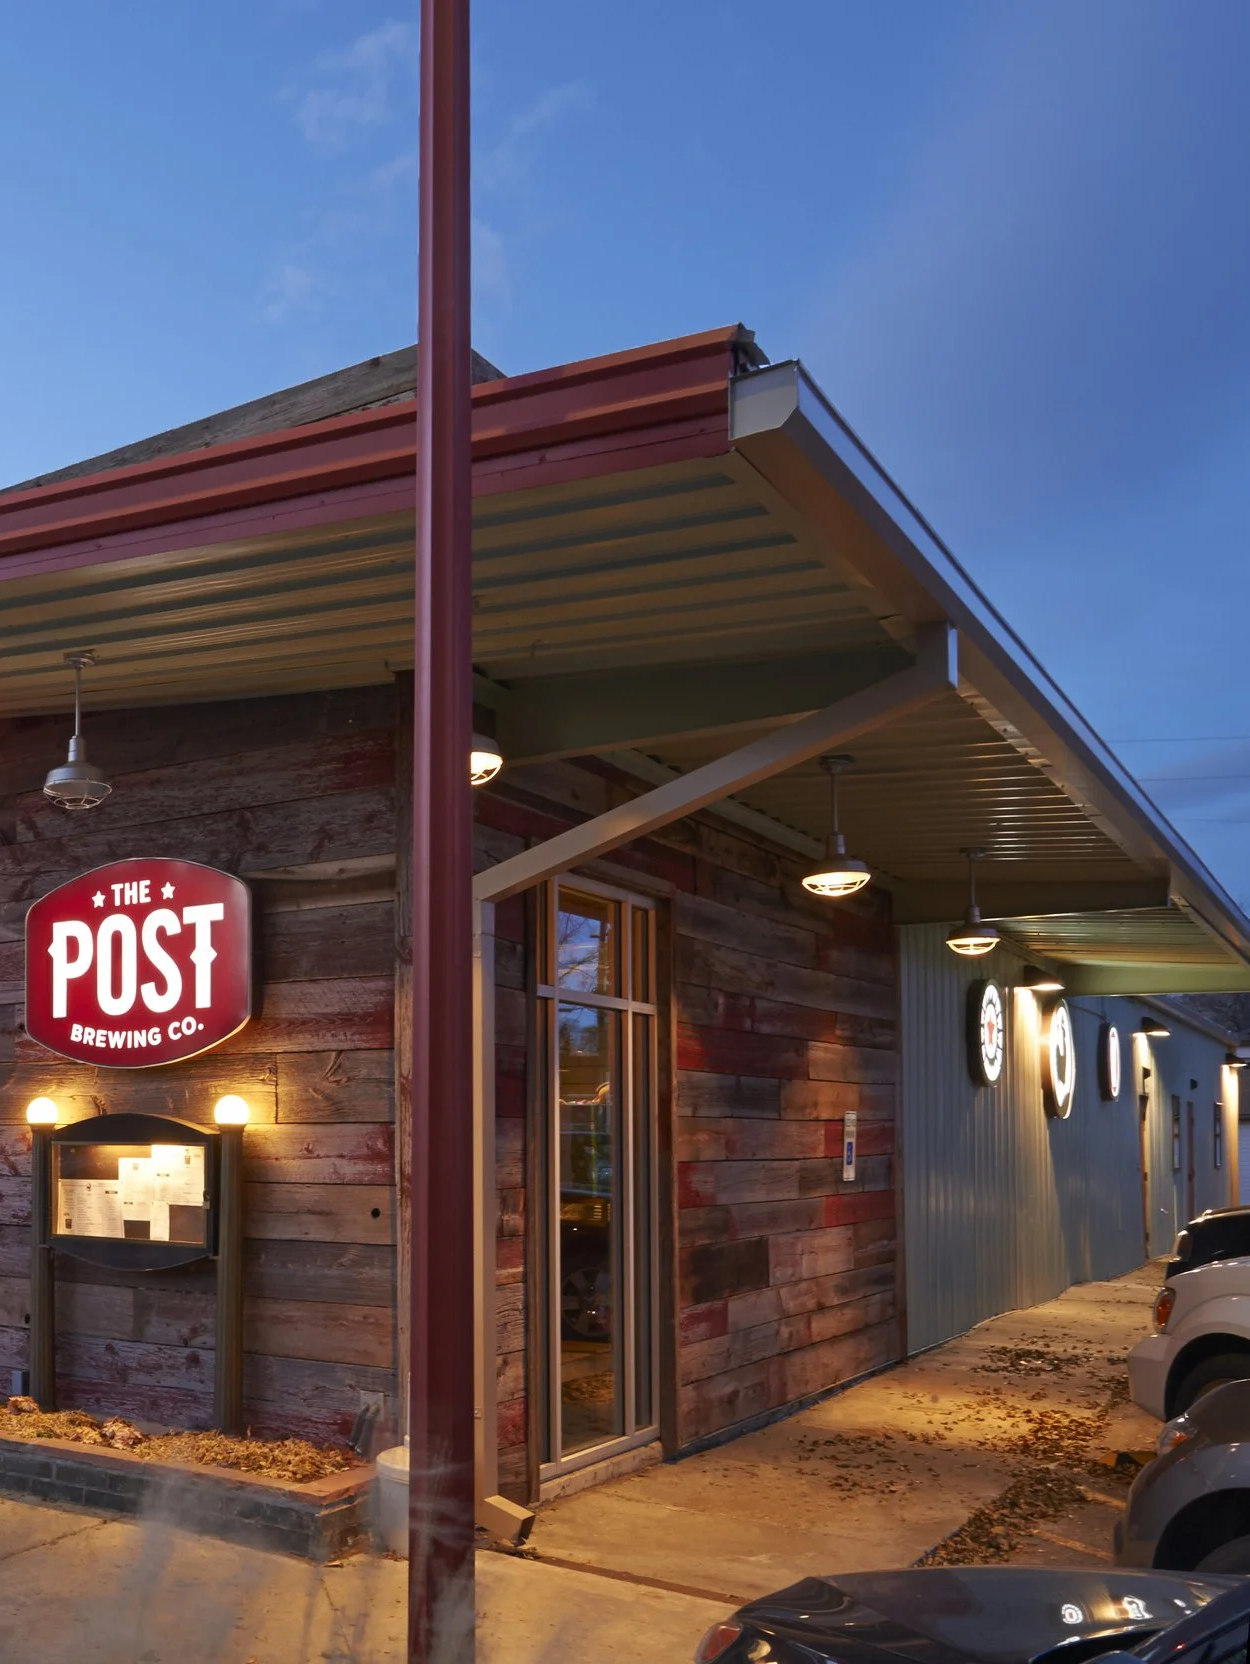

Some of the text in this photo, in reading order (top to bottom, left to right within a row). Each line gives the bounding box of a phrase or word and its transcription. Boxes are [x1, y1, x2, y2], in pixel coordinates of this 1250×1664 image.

[111, 880, 151, 906] THE
[48, 903, 224, 1018] POST
[70, 1016, 204, 1049] BREWING CO.
